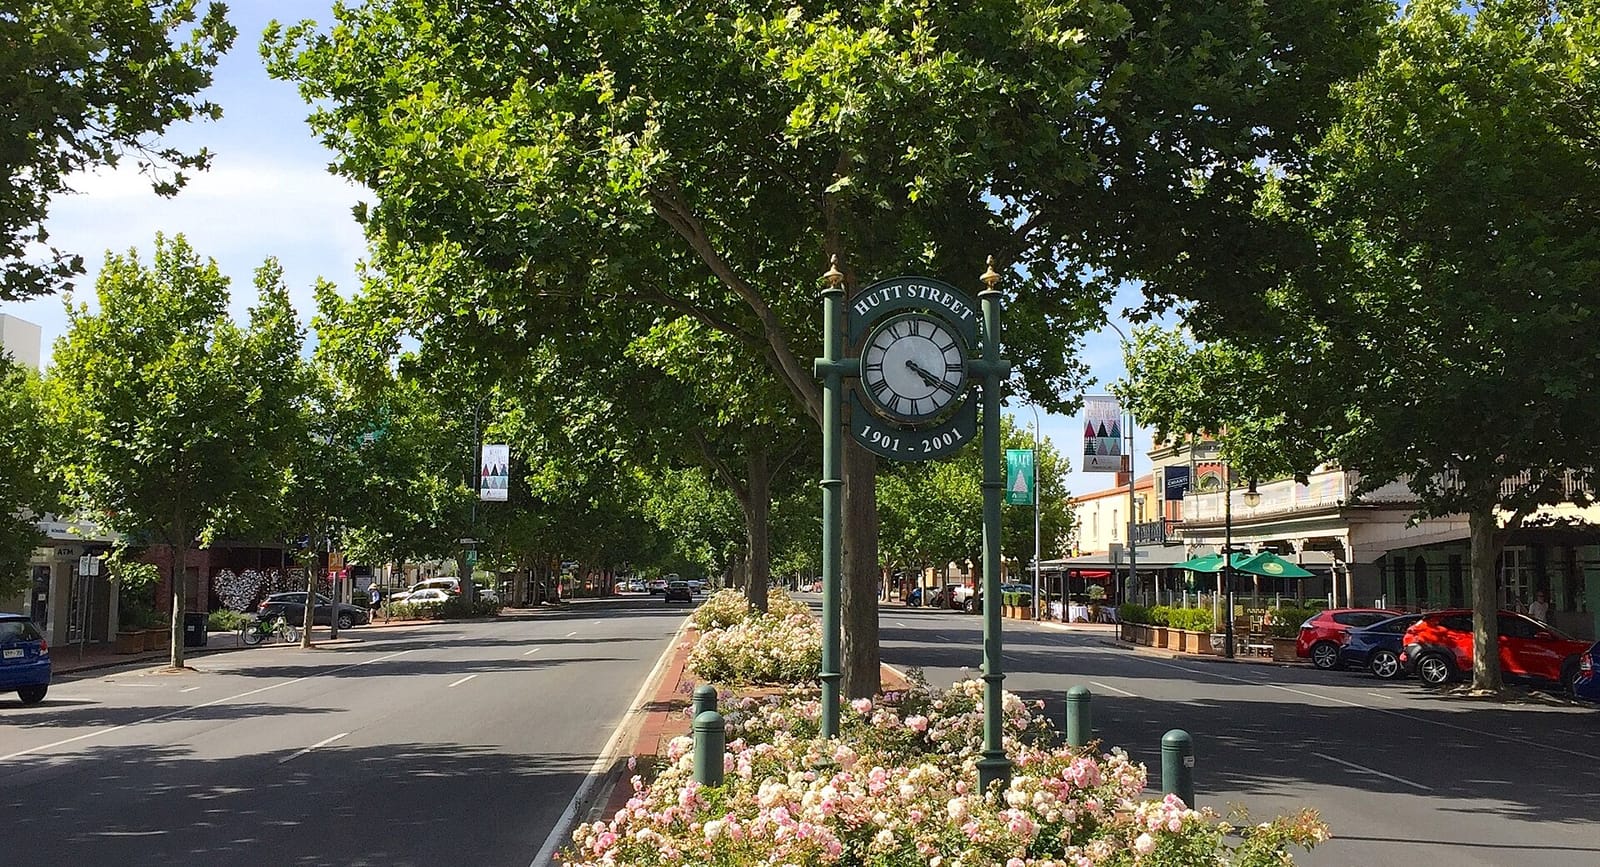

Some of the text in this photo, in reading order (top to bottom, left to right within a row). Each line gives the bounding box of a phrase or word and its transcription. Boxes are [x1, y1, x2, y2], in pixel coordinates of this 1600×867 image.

[854, 284, 974, 320] HUTT STREET
[861, 425, 900, 452] 1901
[922, 427, 963, 453] 2001
